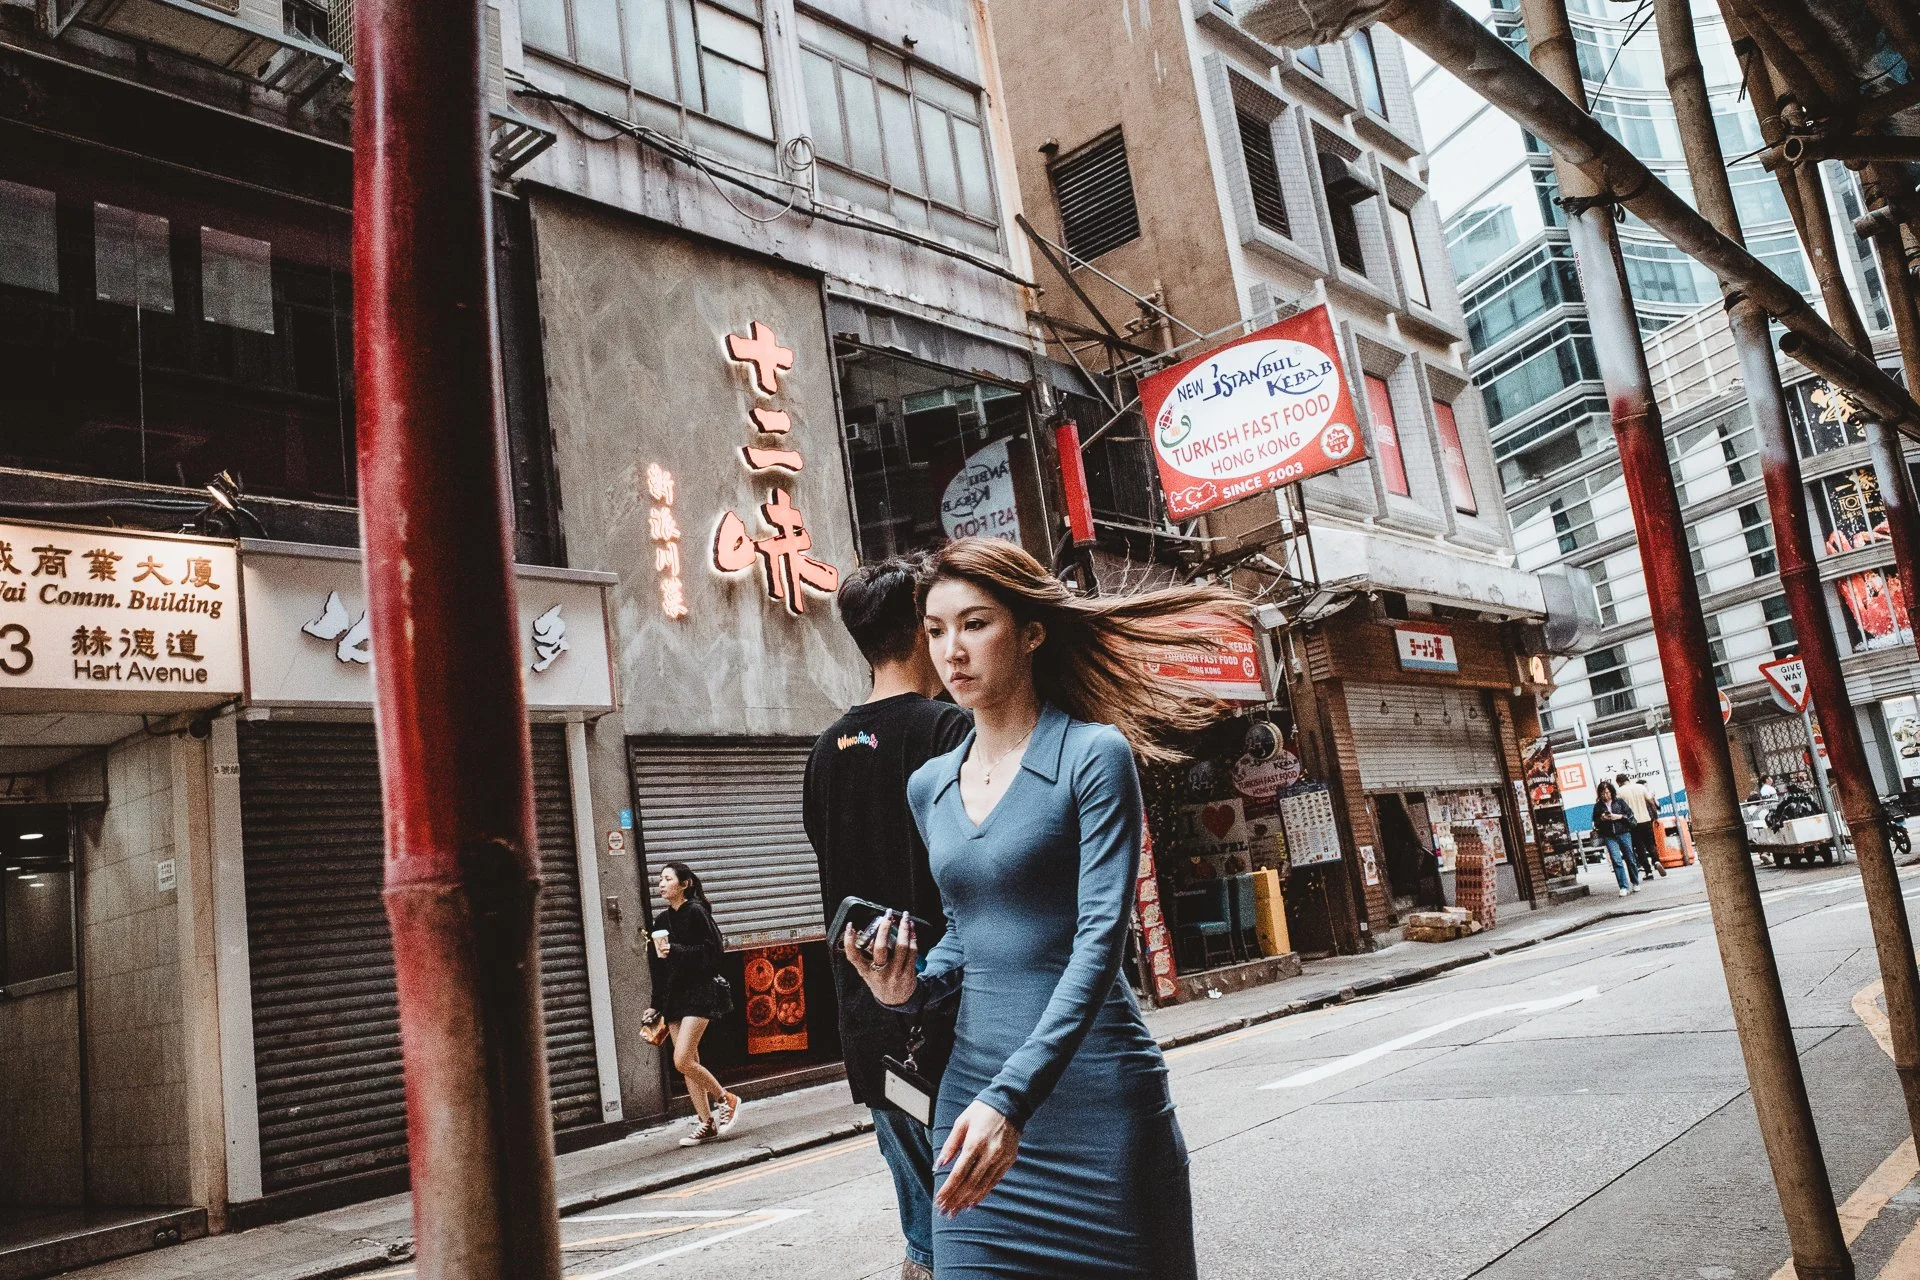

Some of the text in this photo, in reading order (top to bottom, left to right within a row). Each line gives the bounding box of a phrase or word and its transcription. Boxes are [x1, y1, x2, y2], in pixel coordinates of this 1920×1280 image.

[1177, 378, 1204, 402] NEW
[1266, 361, 1333, 397] KEBAB
[1172, 393, 1330, 466] TURKISH FAST FOOD
[713, 320, 839, 614] 十二味
[1211, 448, 1255, 476] HONG
[1257, 431, 1301, 459] KONG
[1222, 461, 1304, 500] SINCE 2003
[39, 583, 121, 609] Comm.
[127, 589, 223, 620] Building
[71, 624, 205, 662] 赫德道
[1228, 641, 1253, 653] KEBAB
[74, 659, 208, 683] Hart Avenue
[1199, 655, 1218, 665] FAST
[1219, 655, 1239, 666] FOOD
[1780, 662, 1802, 674] GIVE
[1783, 671, 1803, 682] WAY
[1280, 770, 1298, 780] FOOD
